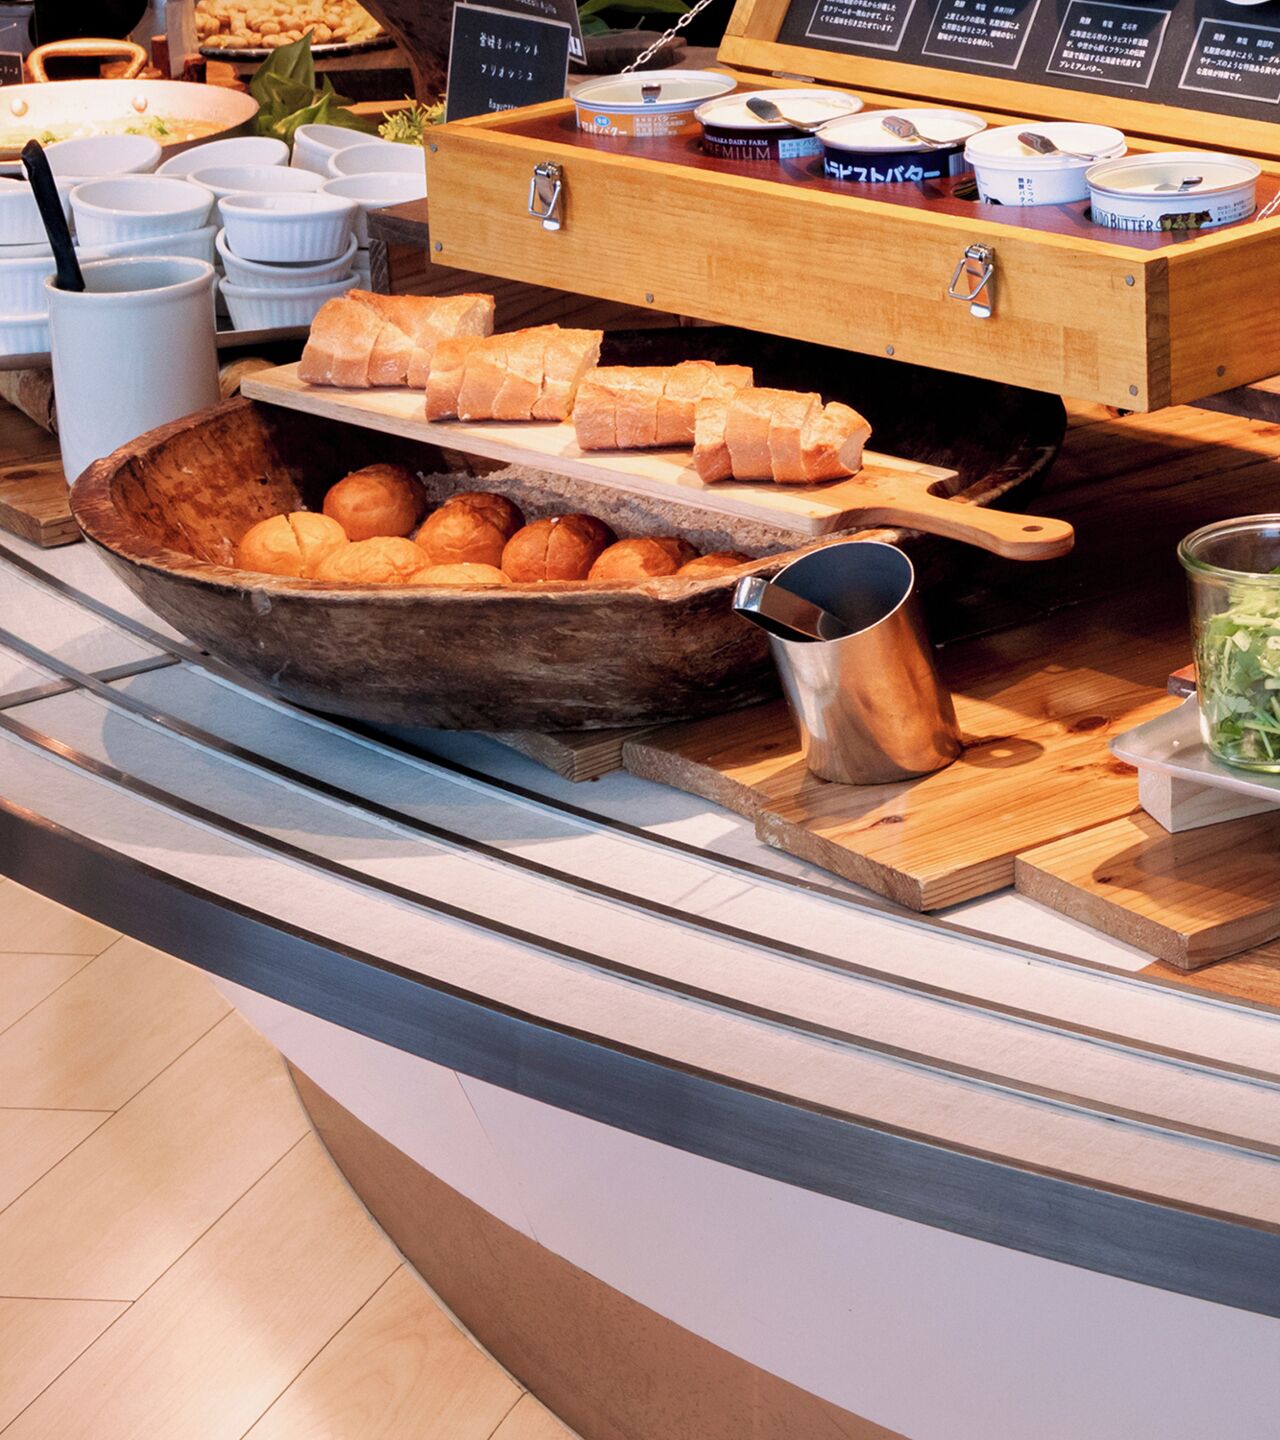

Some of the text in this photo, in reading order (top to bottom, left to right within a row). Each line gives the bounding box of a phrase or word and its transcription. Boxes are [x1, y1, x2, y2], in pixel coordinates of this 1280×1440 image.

[1059, 60, 1104, 75] プレミアムバター。
[728, 138, 747, 146] DAIRY
